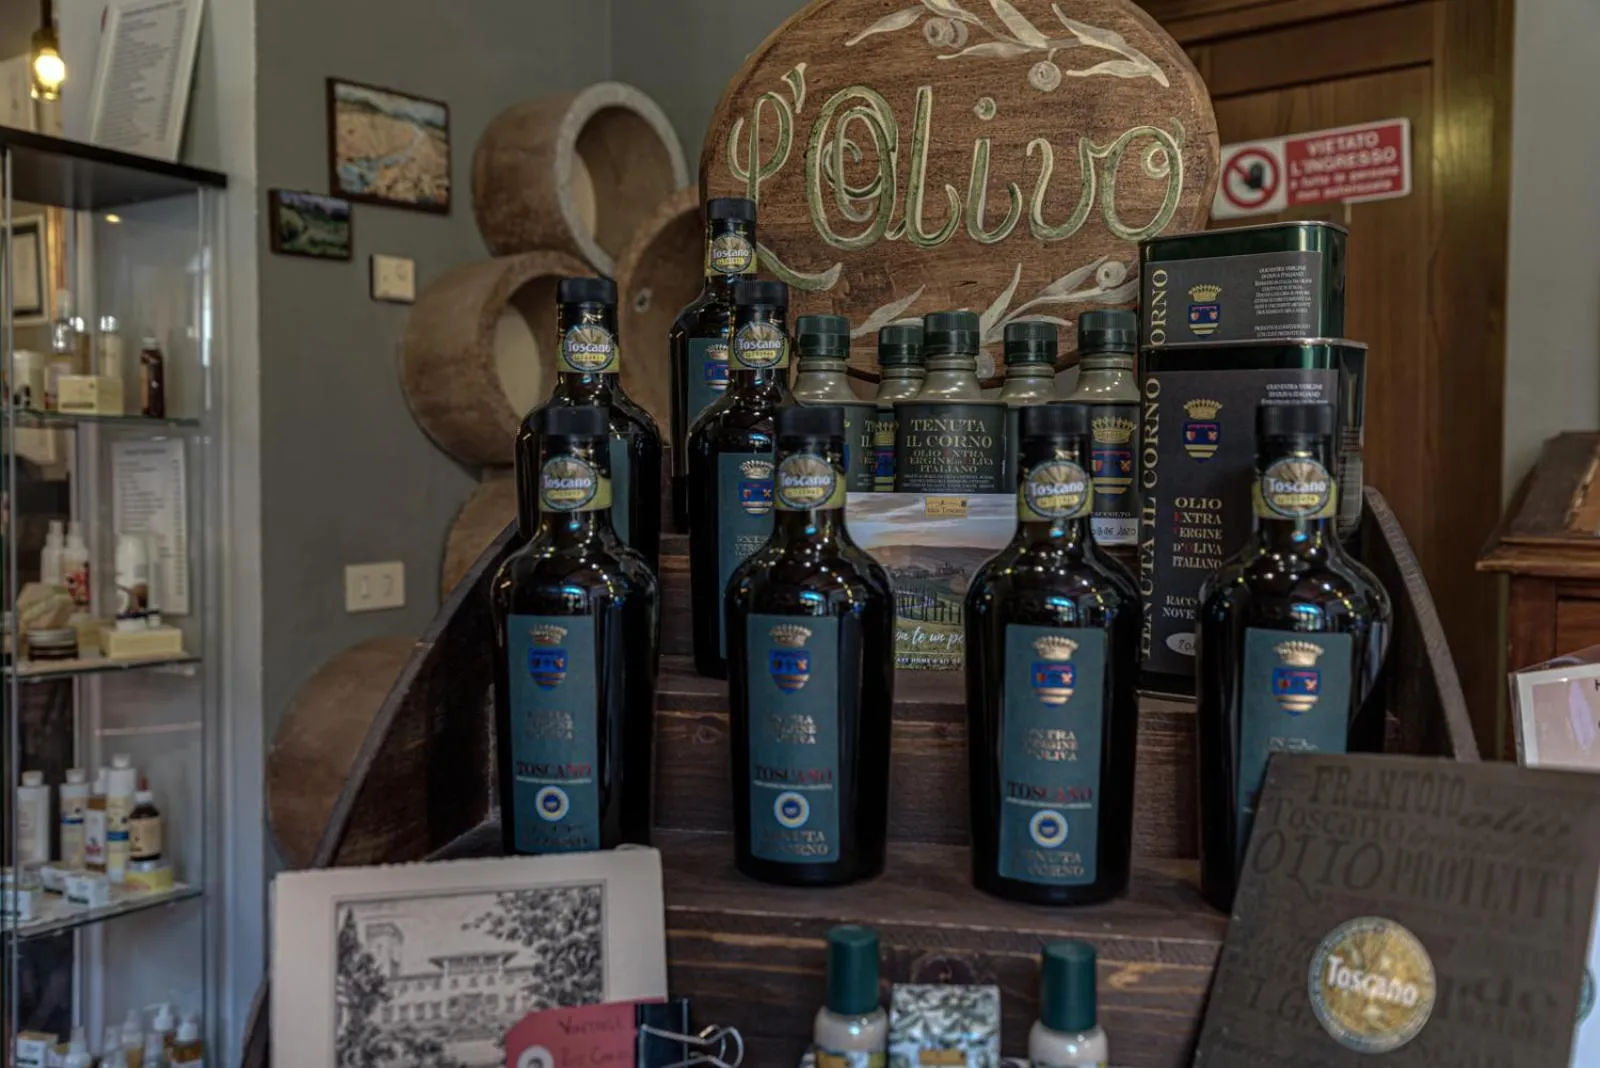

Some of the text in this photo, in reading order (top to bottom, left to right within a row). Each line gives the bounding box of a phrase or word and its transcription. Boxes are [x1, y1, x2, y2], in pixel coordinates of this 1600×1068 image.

[1306, 131, 1379, 157] VIETATO
[1290, 145, 1397, 177] L'INGRESSO
[713, 249, 749, 258] Toscano
[1149, 268, 1168, 345] ORNO
[567, 340, 611, 354] Toscano
[738, 337, 781, 350] Toscano
[910, 418, 987, 433] TENUTA
[1143, 378, 1161, 490] CORNO
[906, 435, 993, 449] IL CORNO
[542, 471, 591, 489] Toscano
[778, 472, 831, 488] Toscano
[1267, 477, 1327, 494] Toscano
[1029, 480, 1085, 498] Toscano
[1174, 497, 1223, 510] OLIO
[1172, 556, 1223, 570] ITALIANO
[1162, 607, 1197, 620] NOVE
[515, 760, 592, 779] TOSCANO
[755, 764, 833, 784] TOSCANO
[1006, 780, 1094, 802] TOSCANO
[1326, 954, 1419, 1008] Toscano
